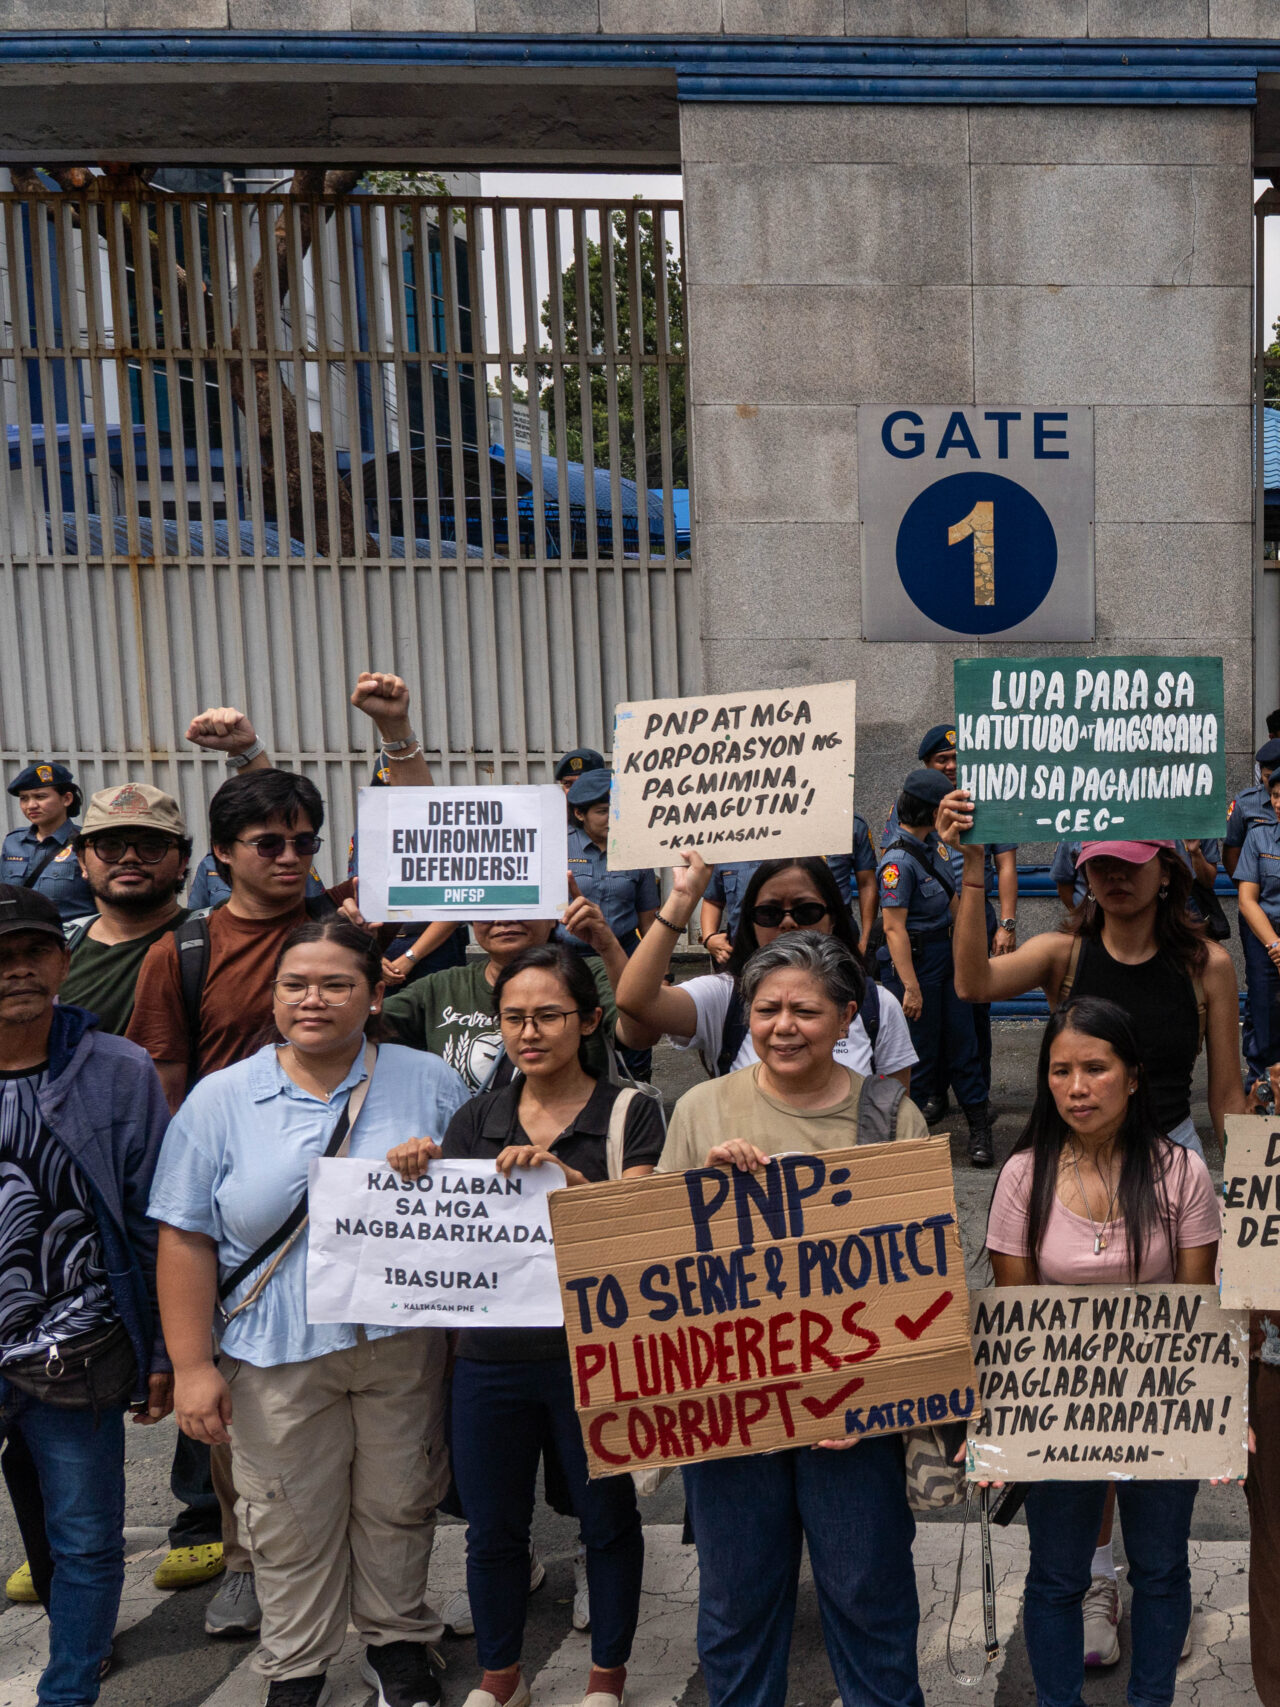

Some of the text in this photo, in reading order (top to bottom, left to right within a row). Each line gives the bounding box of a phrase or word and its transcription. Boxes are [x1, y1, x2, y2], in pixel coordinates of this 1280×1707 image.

[881, 410, 1070, 460] GATE
[948, 501, 995, 606] 1
[991, 669, 1195, 712] LUPA PARA SA
[644, 700, 812, 739] PNP AT MGA
[958, 713, 1218, 754] KATUTUBO AT MAGSASAKA
[623, 731, 842, 773] KORPORASYON NG
[642, 765, 809, 801] PAGMIMINA,
[961, 763, 1213, 803] HINDI SA PAGMIMINA
[428, 801, 503, 825] DEFEND
[648, 788, 815, 828] PANAGUTIN!
[392, 828, 537, 854] ENVIRONMENT
[401, 856, 529, 881] DEFENDERS!!
[444, 888, 485, 903] PNFSP
[367, 1172, 522, 1196] KASO LABAN
[682, 1154, 852, 1253] PNP:
[395, 1198, 489, 1218] SA MGA
[335, 1217, 554, 1245] NAGBABARIKADA,
[384, 1267, 498, 1290] IBASURA!
[566, 1212, 956, 1334] TO SERVE & PROTECT
[403, 1303, 455, 1312] KALIKASAN
[575, 1301, 881, 1407] PLUNDERERS
[974, 1332, 1240, 1368] ANG MAGPROTESTA,
[978, 1365, 1196, 1400] IPAGLABAN ANG
[588, 1381, 803, 1465] CORRUPT
[844, 1386, 976, 1435] KATRIBU
[976, 1395, 1232, 1437] ATING KARAPATAN!
